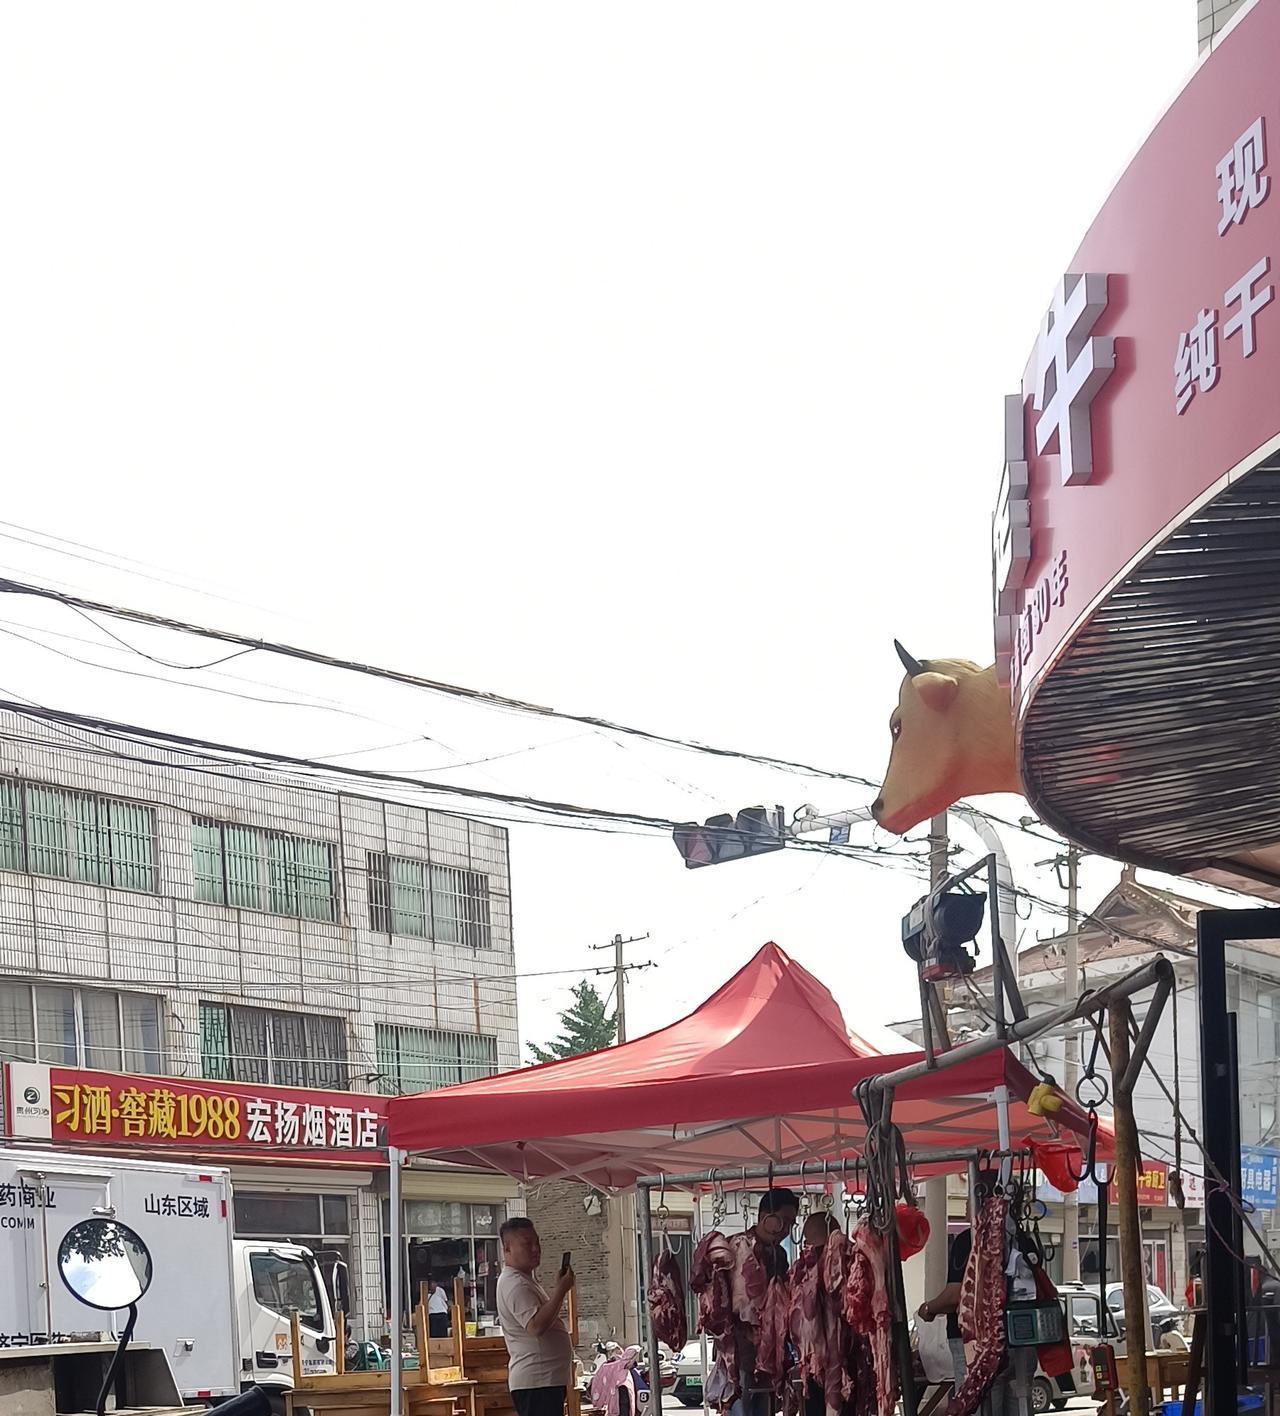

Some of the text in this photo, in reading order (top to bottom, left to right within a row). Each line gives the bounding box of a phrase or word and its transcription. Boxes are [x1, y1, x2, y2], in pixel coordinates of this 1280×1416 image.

[1215, 115, 1270, 237] 现
[245, 1098, 379, 1148] 宏扬烟酒店
[145, 1193, 210, 1218] 山东区域
